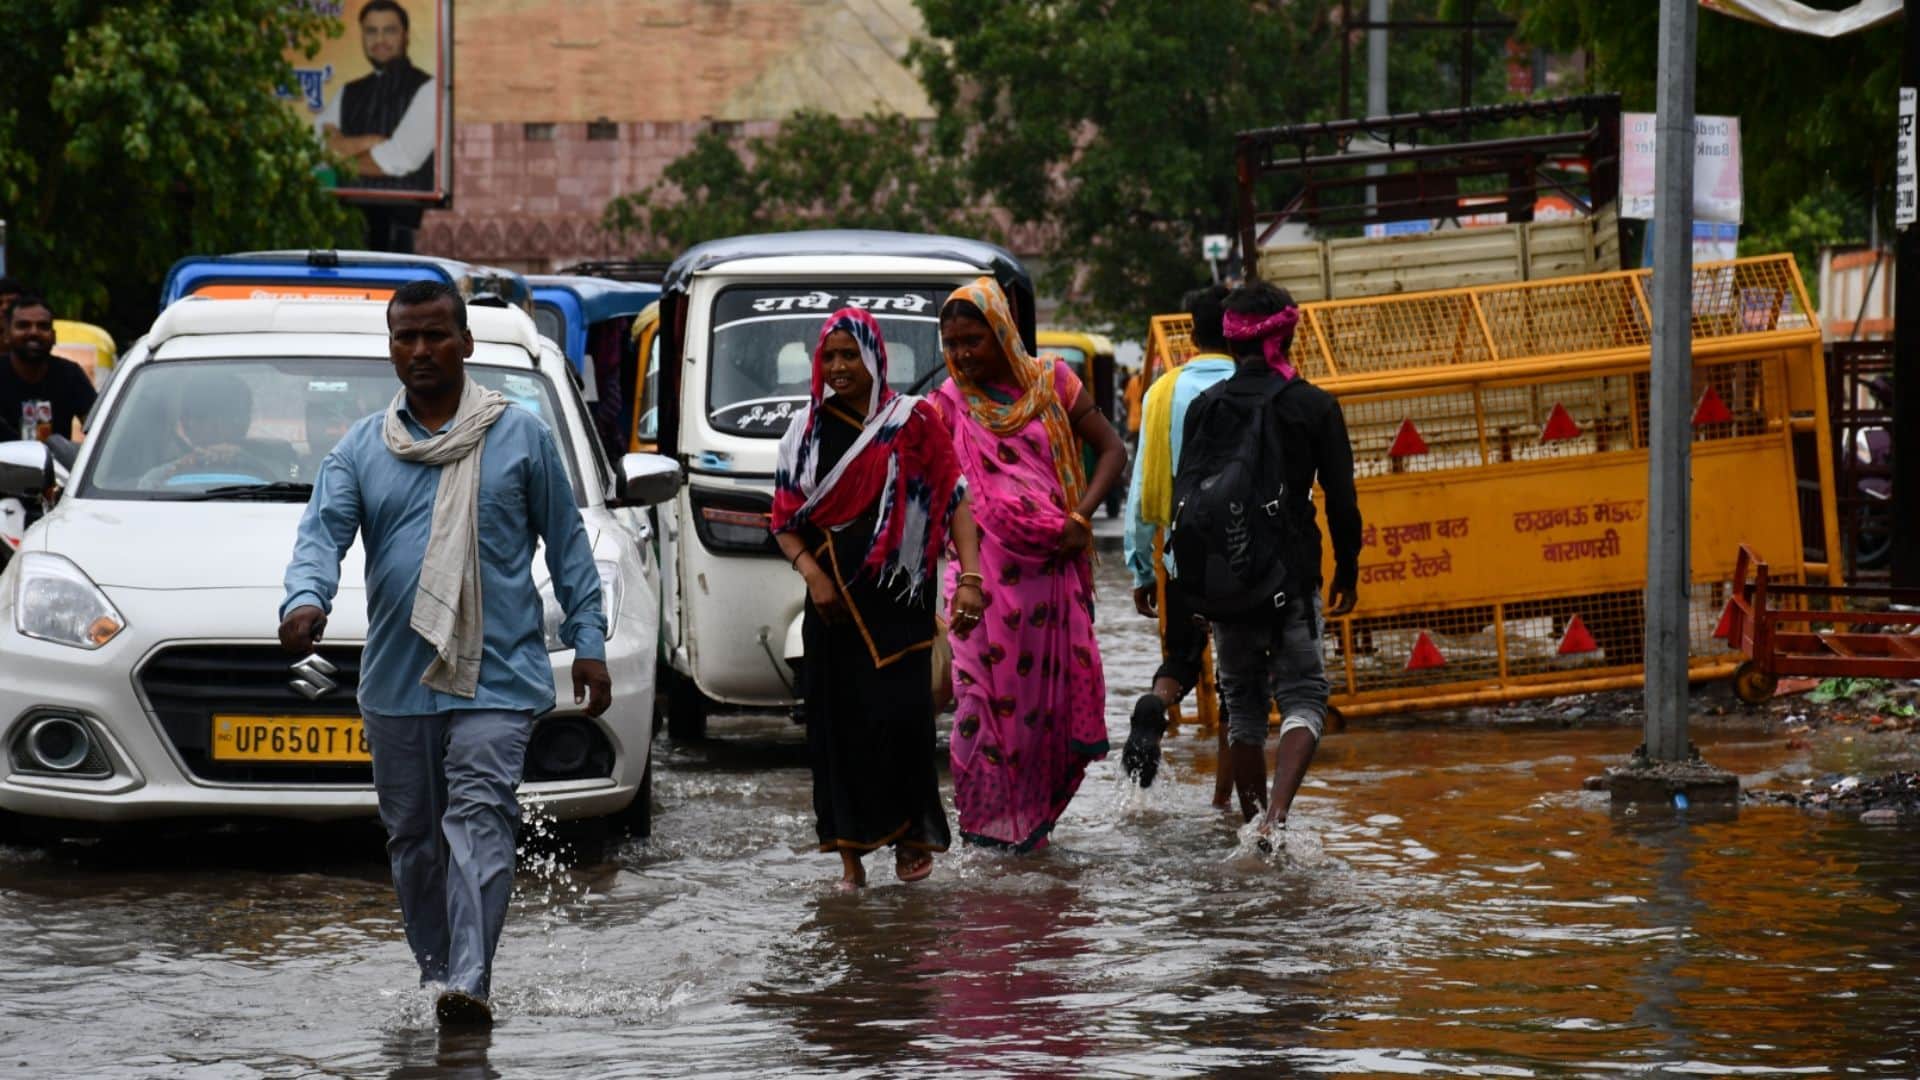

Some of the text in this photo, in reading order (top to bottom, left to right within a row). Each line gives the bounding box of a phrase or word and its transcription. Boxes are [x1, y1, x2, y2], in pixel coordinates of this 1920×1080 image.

[752, 291, 932, 312] राधे राधे
[1513, 504, 1589, 533] लखनऊ
[1410, 548, 1452, 578] रेलवे
[236, 726, 371, 754] UP65QT18
